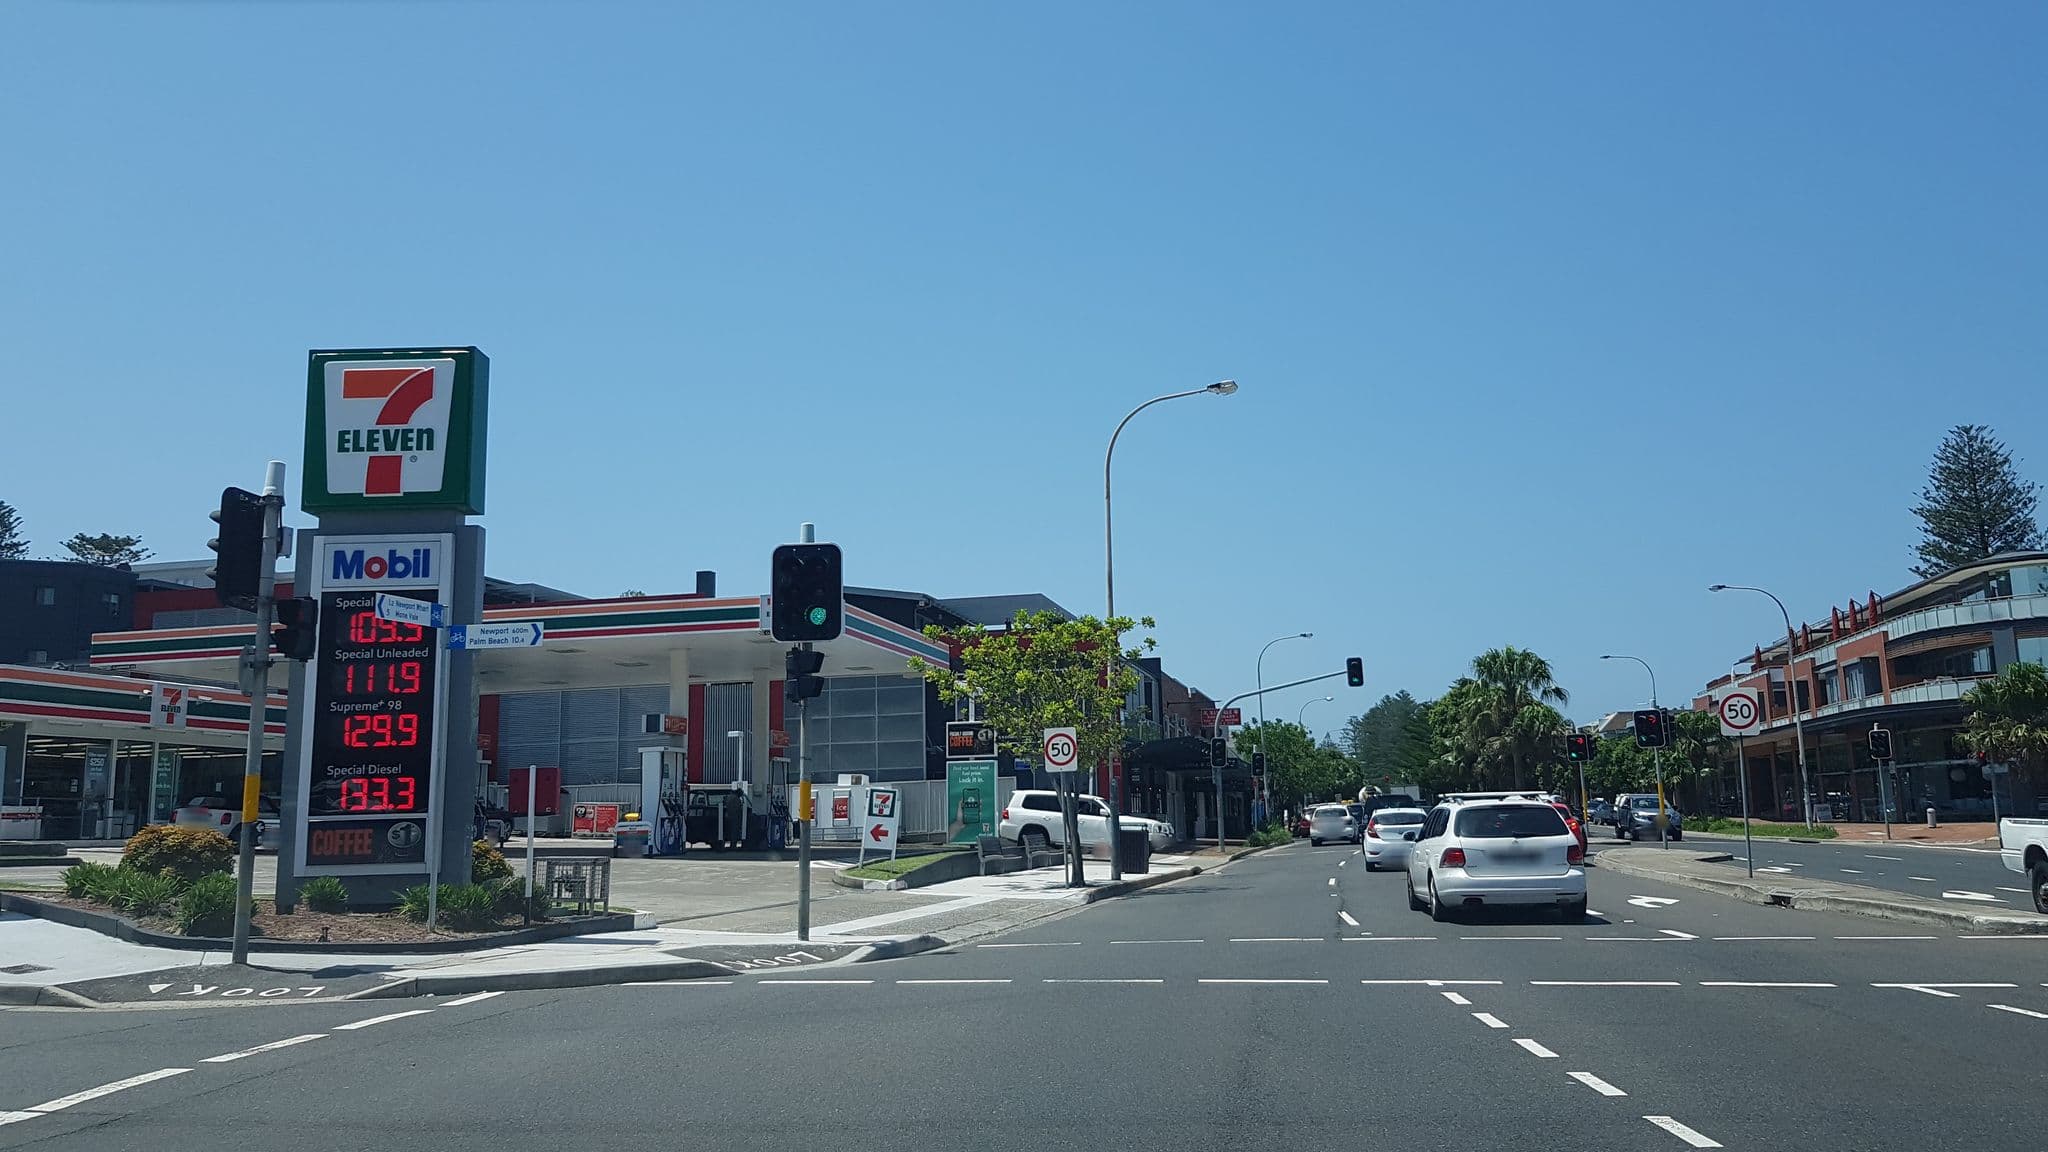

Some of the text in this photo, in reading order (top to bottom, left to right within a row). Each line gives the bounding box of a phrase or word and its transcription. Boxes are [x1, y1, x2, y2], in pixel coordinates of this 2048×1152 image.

[343, 367, 434, 494] 7
[332, 548, 430, 579] Mobil
[336, 596, 374, 610] Special
[480, 627, 509, 636] Newport
[470, 637, 486, 645] Palm
[488, 637, 508, 645] Beach
[335, 647, 429, 661] Special Unleaded
[346, 661, 421, 694] 111.9
[163, 688, 181, 724] 7
[387, 700, 402, 711] 98
[1727, 703, 1752, 720] 50
[344, 713, 419, 748] 129.9
[949, 736, 973, 747] COFFEE
[1051, 742, 1071, 757] 50
[327, 764, 402, 778] Special Diesel
[340, 776, 416, 811] 133.3
[312, 828, 373, 856] COFFEE
[724, 951, 823, 968] LOOK
[177, 984, 326, 997] LOOK
